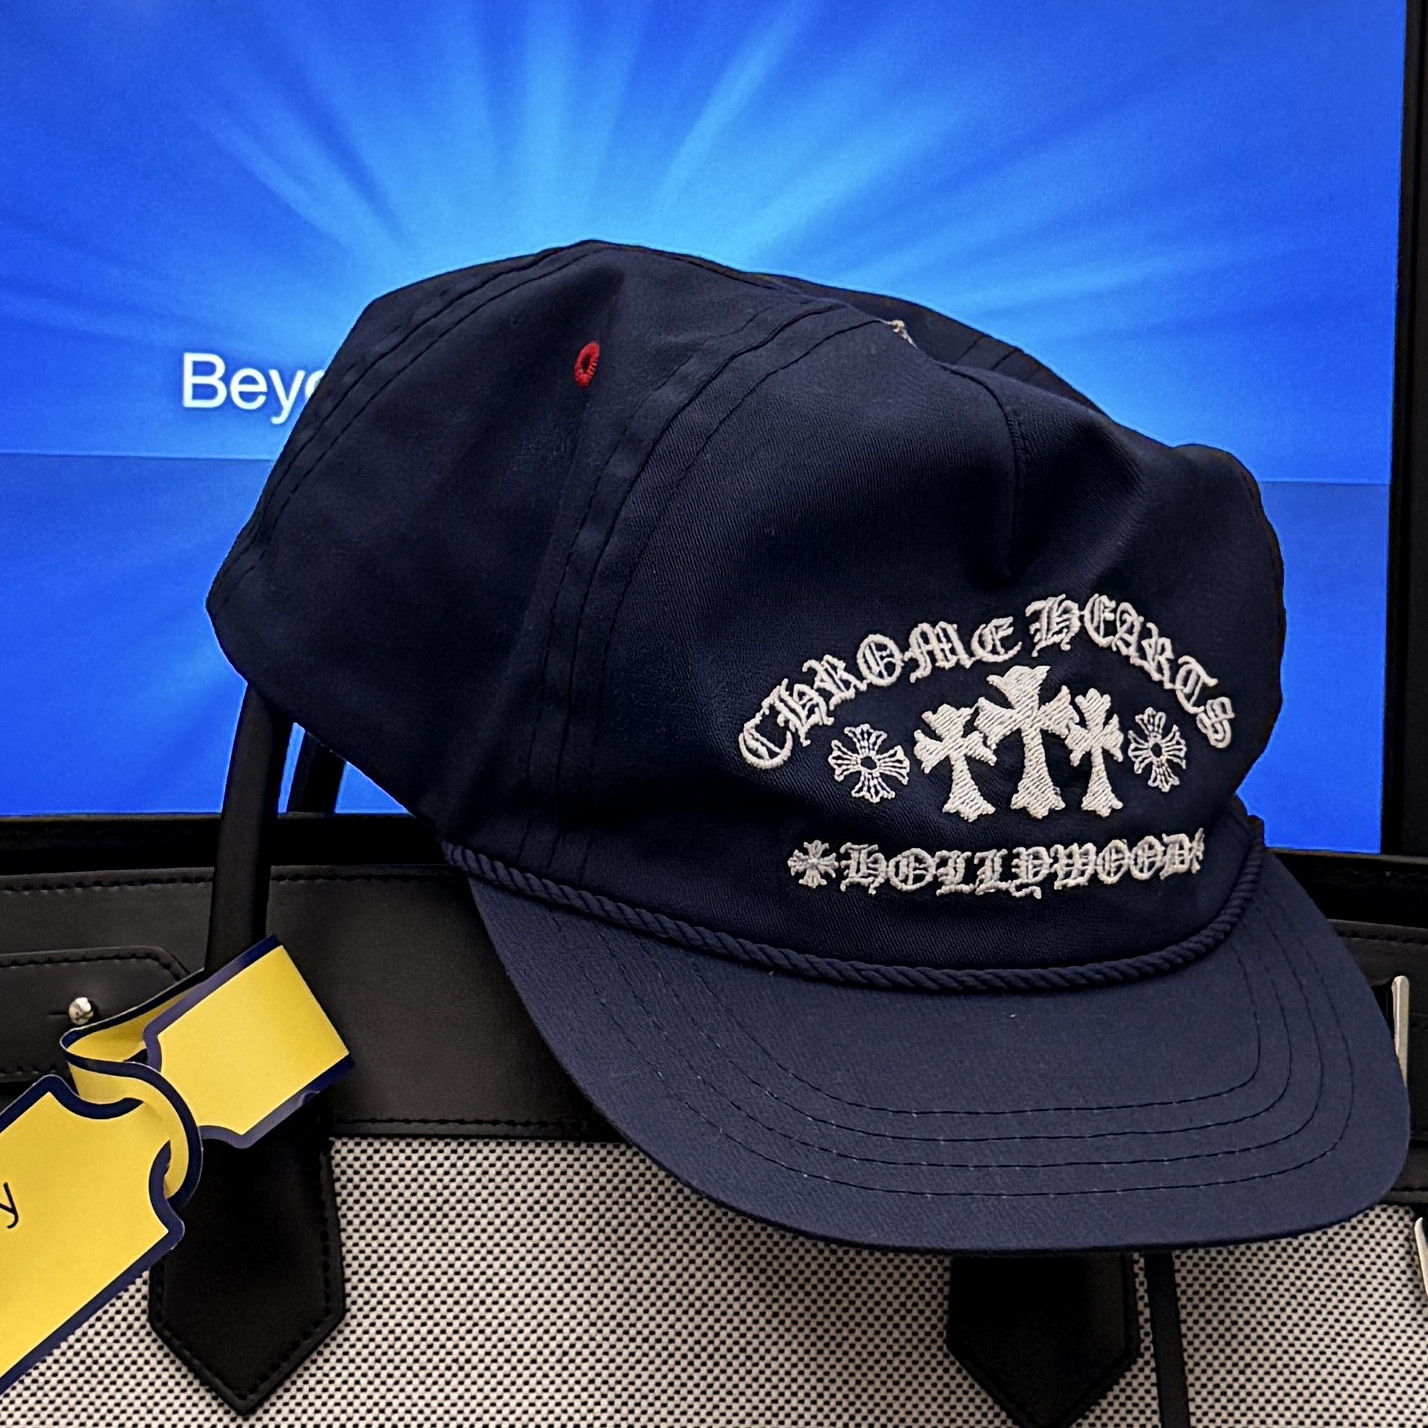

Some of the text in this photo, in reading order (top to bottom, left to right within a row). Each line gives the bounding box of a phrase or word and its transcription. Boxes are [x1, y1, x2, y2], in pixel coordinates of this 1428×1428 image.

[737, 592, 1237, 770] CHROME HEARTS
[838, 830, 1194, 900] HOLLYWOOD
